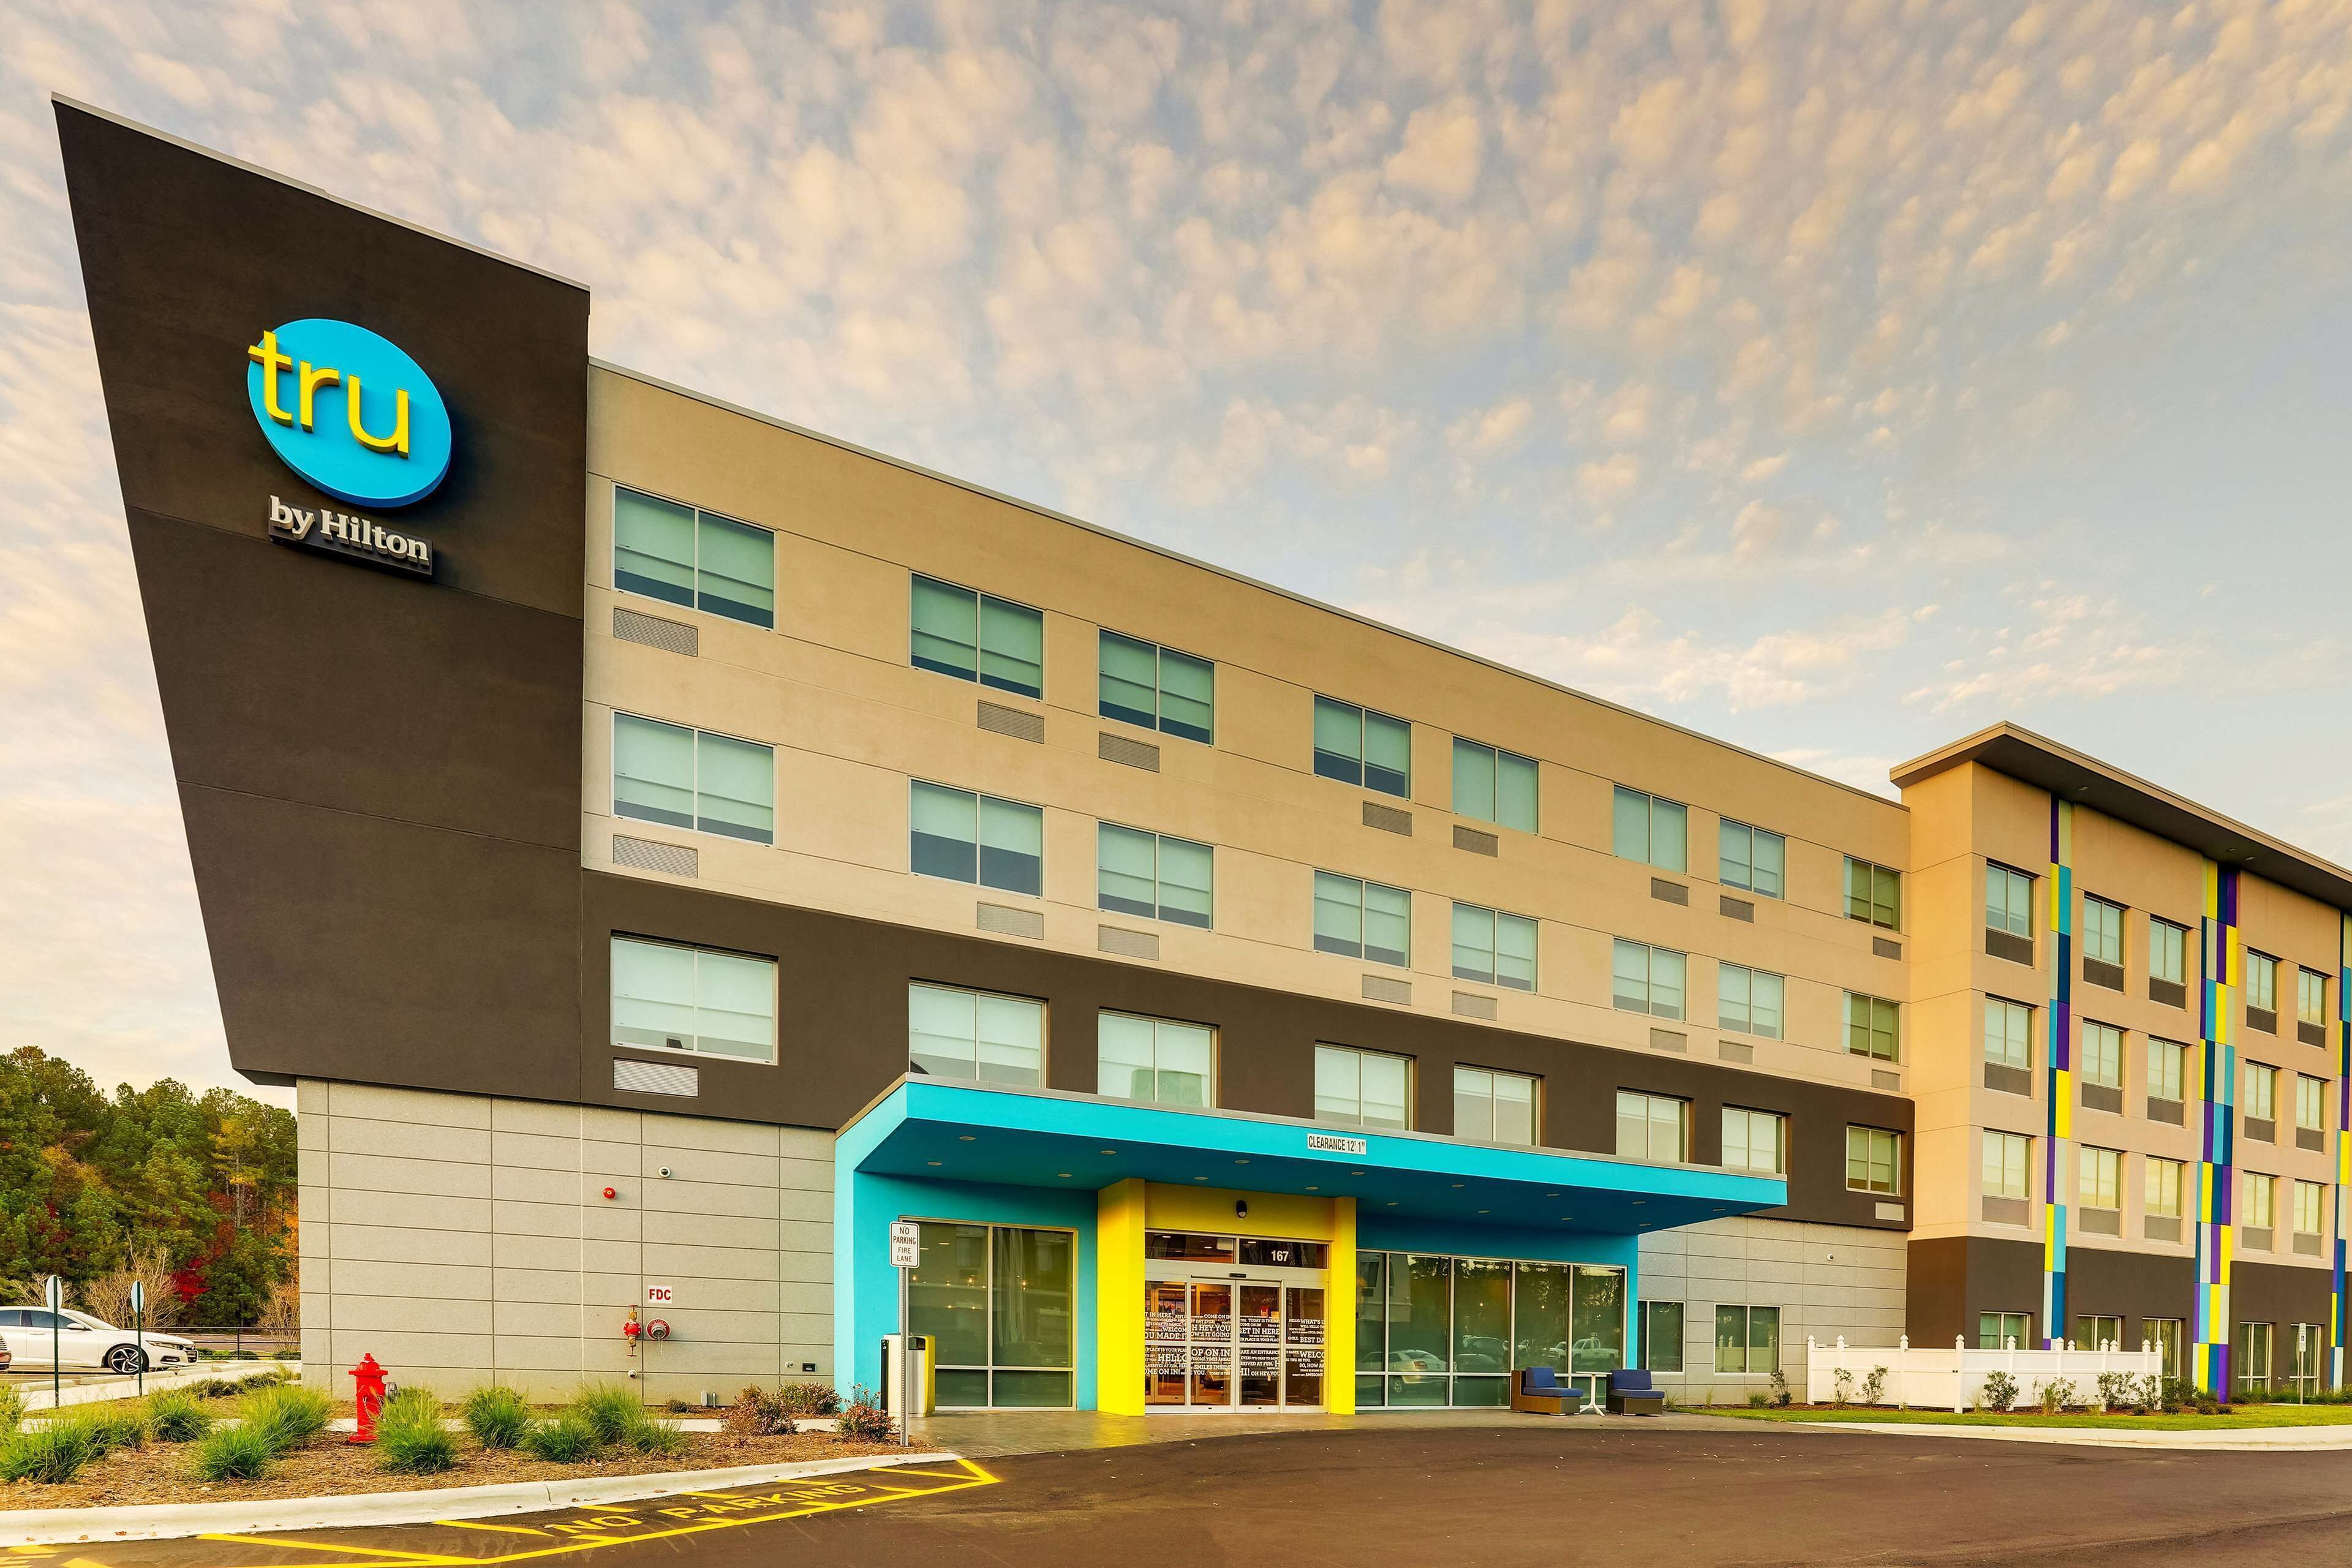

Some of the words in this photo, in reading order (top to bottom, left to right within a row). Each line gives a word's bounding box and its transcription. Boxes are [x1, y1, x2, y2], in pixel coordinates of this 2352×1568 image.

[248, 330, 410, 459] tru
[270, 495, 315, 540] by
[320, 508, 430, 566] Hilton
[1309, 1136, 1345, 1150] CLEARANCE
[1347, 1140, 1356, 1152] 12'
[893, 1236, 916, 1245] PARKING
[1272, 1250, 1289, 1262] 167
[649, 1289, 671, 1300] FDC
[552, 1515, 643, 1534] NO
[657, 1485, 867, 1519] PARKING
